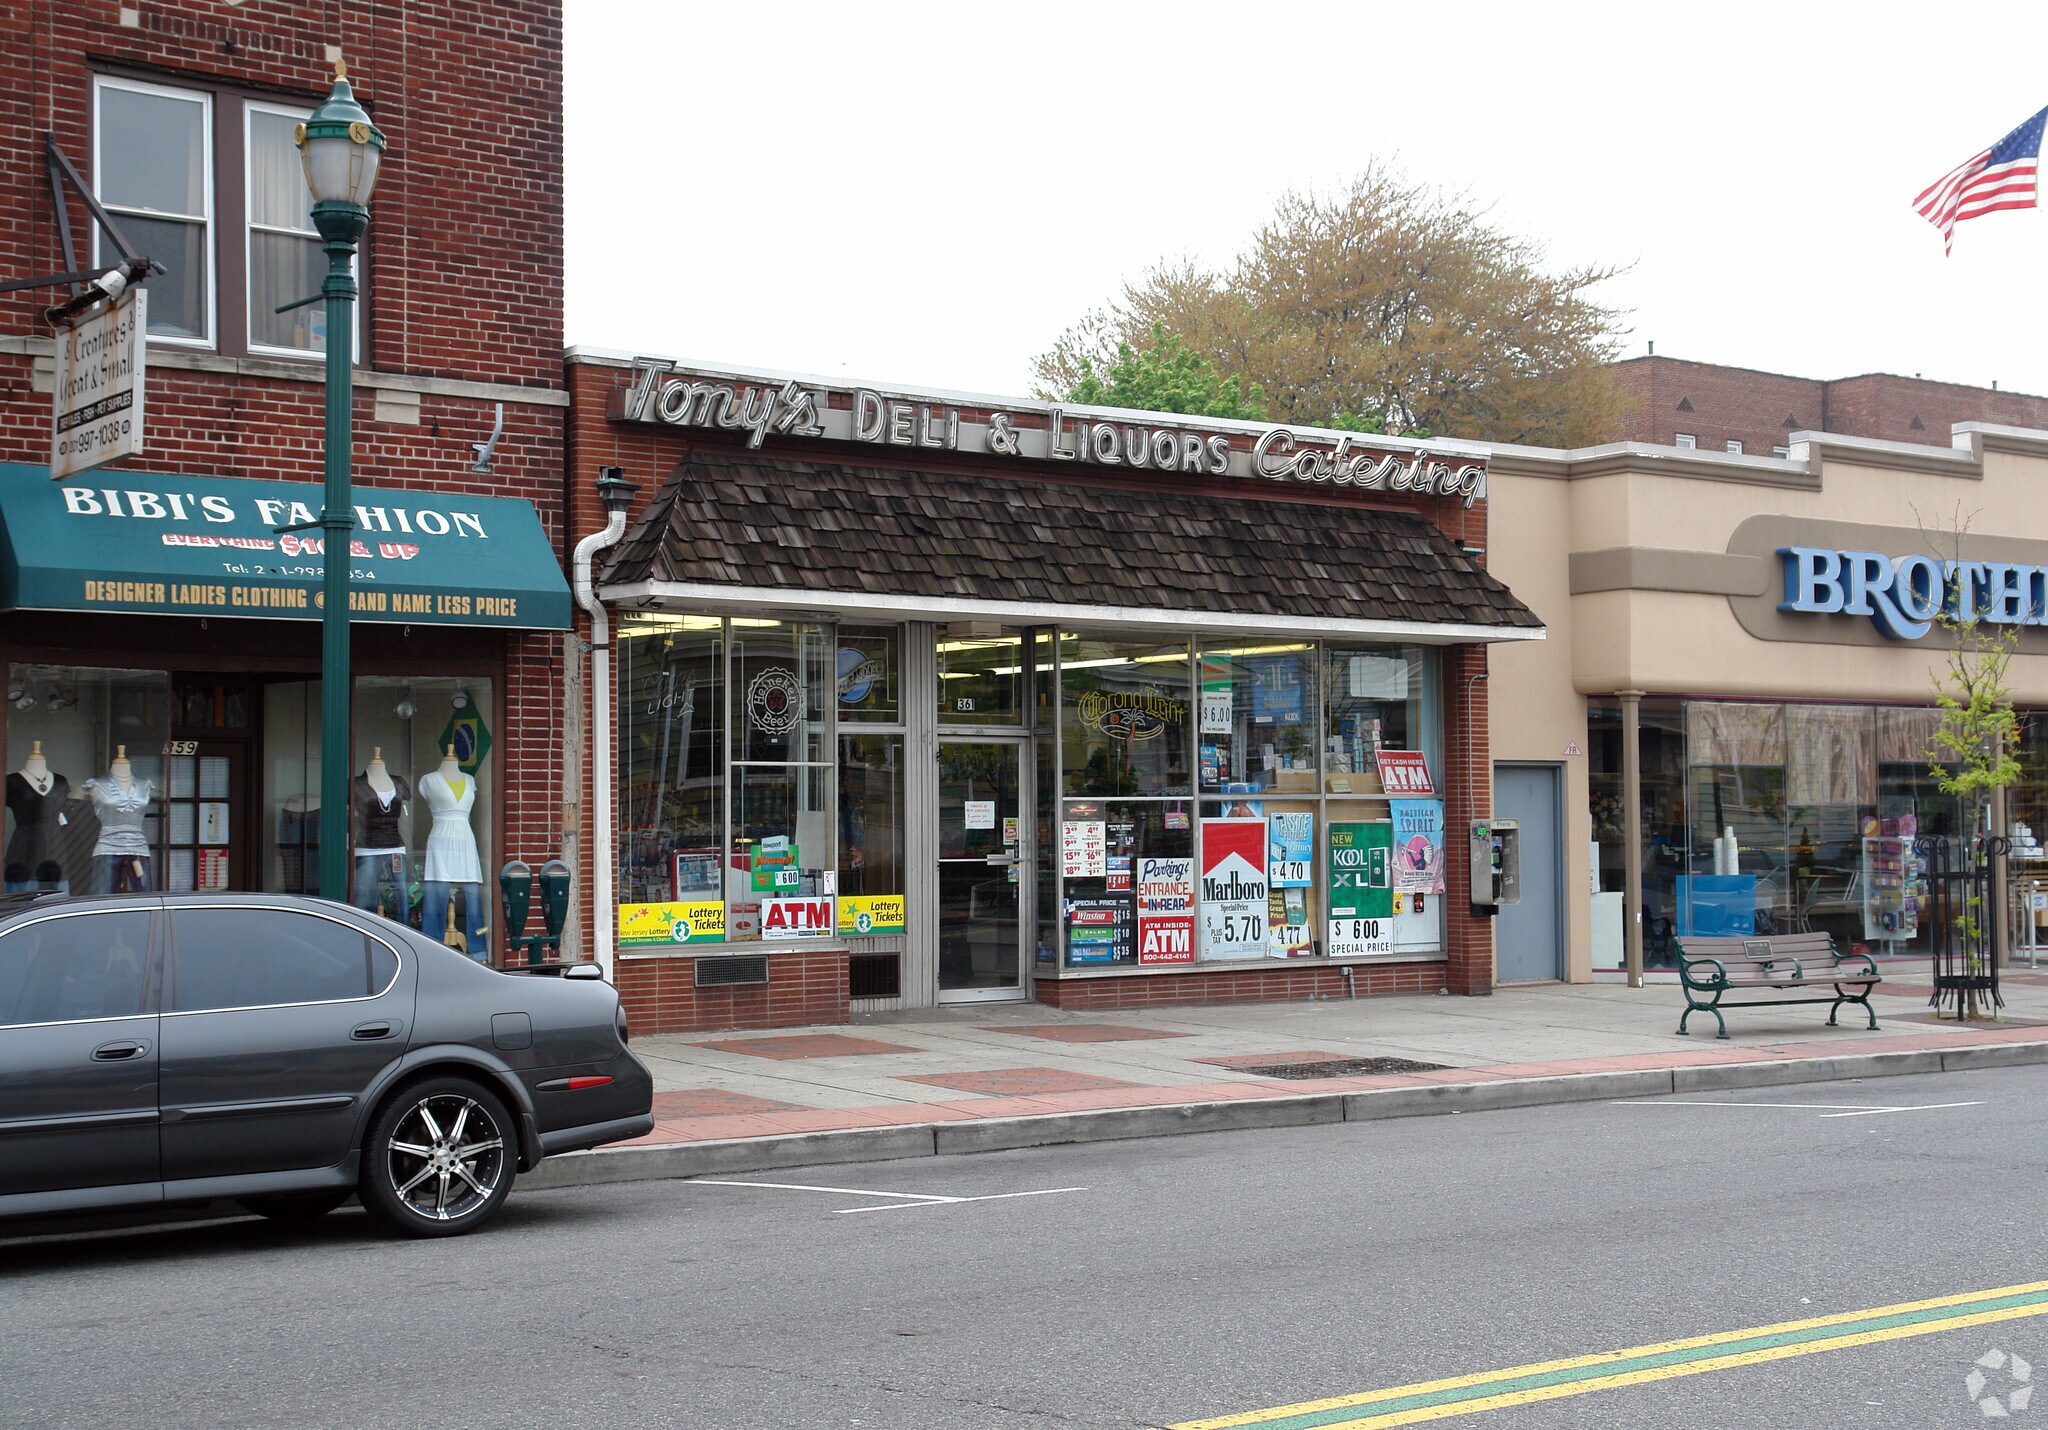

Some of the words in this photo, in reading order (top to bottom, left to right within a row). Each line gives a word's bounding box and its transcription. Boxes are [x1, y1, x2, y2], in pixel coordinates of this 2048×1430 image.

[75, 322, 126, 362] Creatures
[101, 341, 134, 386] Small
[852, 387, 960, 450] DELI
[986, 412, 1022, 455] &
[1050, 408, 1229, 476] LIQUORS
[1252, 429, 1487, 510] Catering
[62, 488, 236, 523] BIBI'S
[254, 499, 488, 538] FAHION
[162, 534, 275, 550] EVERYTHING
[279, 534, 325, 557] $1
[378, 542, 420, 560] UP
[223, 563, 249, 574] Tel:
[85, 580, 165, 603] DESIGNER
[171, 584, 226, 605] LADIES
[232, 586, 307, 608] CLOTHING
[350, 591, 386, 612] RAND
[393, 594, 432, 614] NAME
[438, 595, 470, 615] LESS
[476, 597, 517, 616] PRICE
[1777, 546, 2048, 640] BROTH
[754, 677, 796, 705] Heineken
[648, 688, 695, 714] LIGHT
[959, 700, 974, 710] 361
[1078, 691, 1142, 729] Corona
[1144, 686, 1184, 725] Light
[762, 711, 788, 727] Beer
[1211, 707, 1230, 722] 6.00
[1385, 766, 1430, 790] ATM
[1400, 809, 1434, 817] AMERICAN
[1274, 814, 1310, 831] TASTE
[1400, 818, 1434, 832] SPIRIT
[1284, 830, 1308, 841] FUTURE
[1332, 835, 1353, 844] NEW
[1334, 849, 1368, 866] KOOL
[1142, 859, 1185, 882] Parking
[1280, 862, 1303, 880] 4.70
[1203, 871, 1264, 901] Marlboro
[1333, 873, 1368, 887] XL
[1138, 882, 1189, 896] ENTRANCE
[871, 902, 900, 912] Lottery
[1148, 898, 1157, 911] IN
[1161, 898, 1185, 910] REAR
[1221, 904, 1236, 913] Special
[689, 908, 723, 920] Lottery
[765, 902, 830, 929] ATM
[875, 912, 903, 922] Tickets
[694, 920, 725, 930] Tickets
[1207, 916, 1212, 928] $
[1225, 915, 1261, 942] 5.70
[1335, 921, 1341, 936] $
[1353, 920, 1379, 939] 6.00
[1143, 929, 1189, 953] ATM
[1278, 926, 1300, 945] 4.77
[1331, 943, 1364, 954] SPECIAL
[1367, 942, 1393, 952] PRICE!
